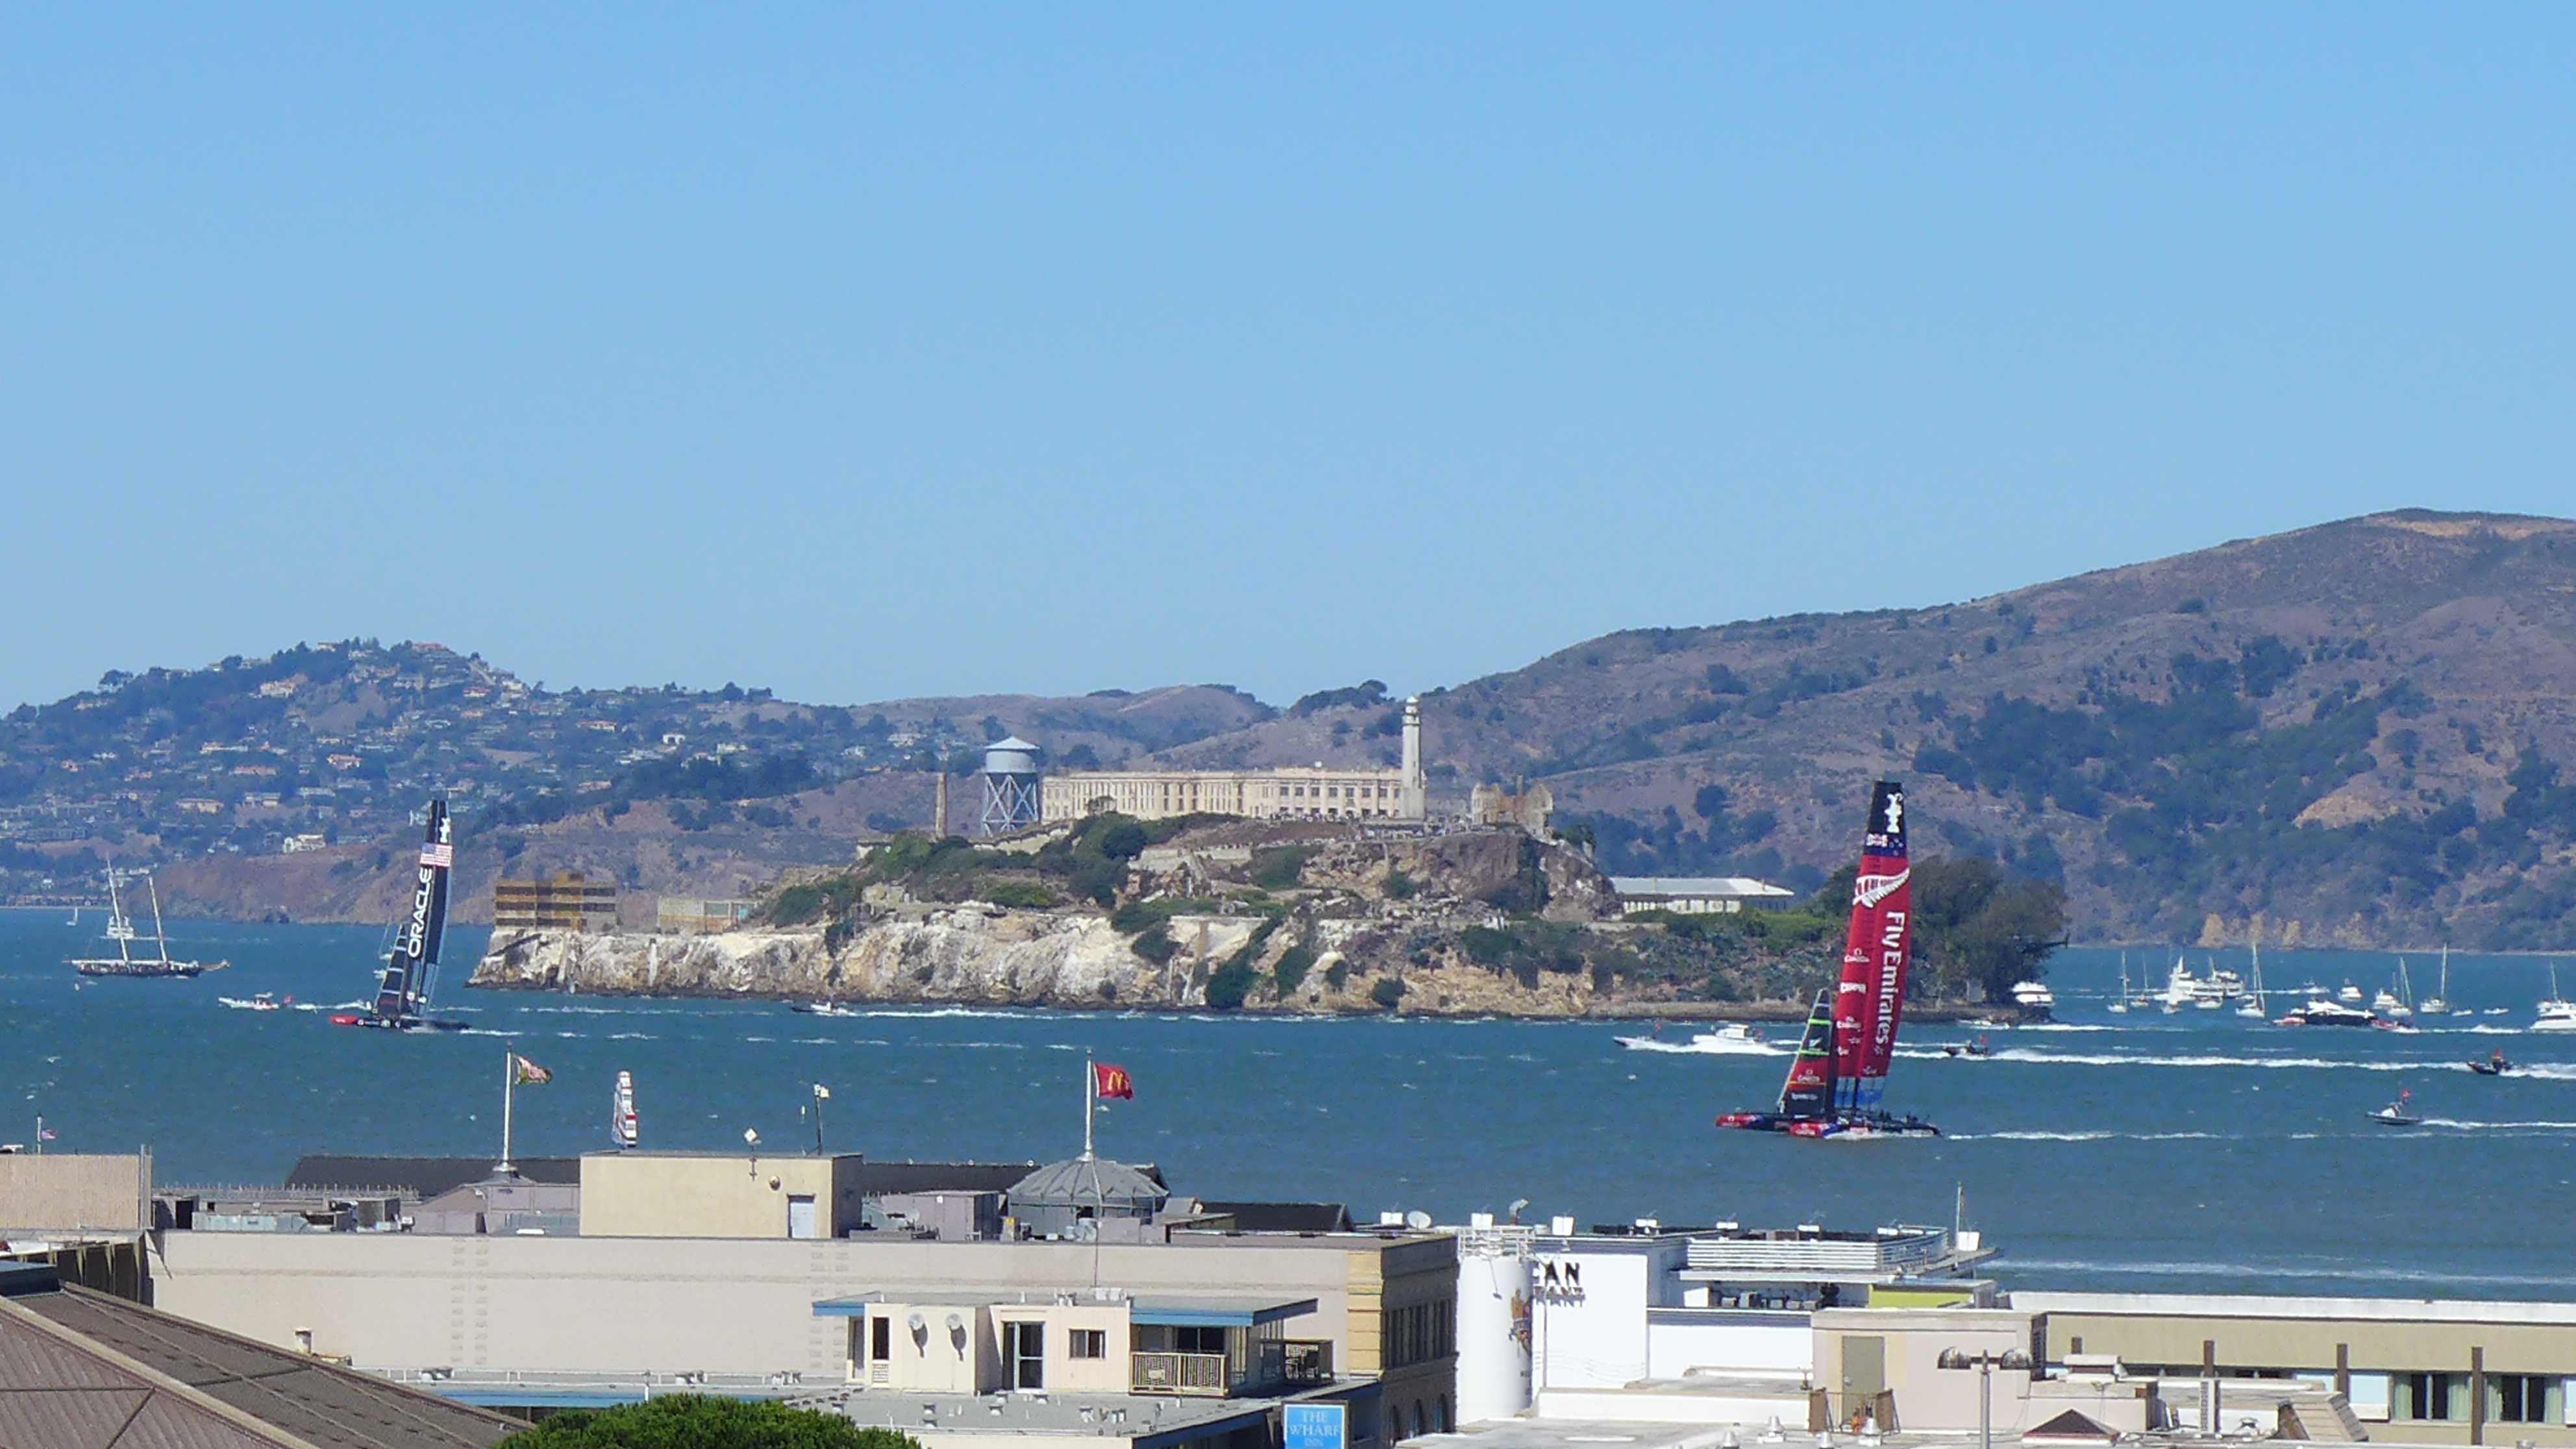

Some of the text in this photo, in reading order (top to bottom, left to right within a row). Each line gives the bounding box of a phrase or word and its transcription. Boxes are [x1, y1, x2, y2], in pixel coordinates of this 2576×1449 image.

[408, 867, 433, 958] ORACLE
[1876, 911, 1905, 1045] Fly Emirates
[1289, 1424, 1339, 1436] WHARF
[1302, 1411, 1328, 1422] THE
